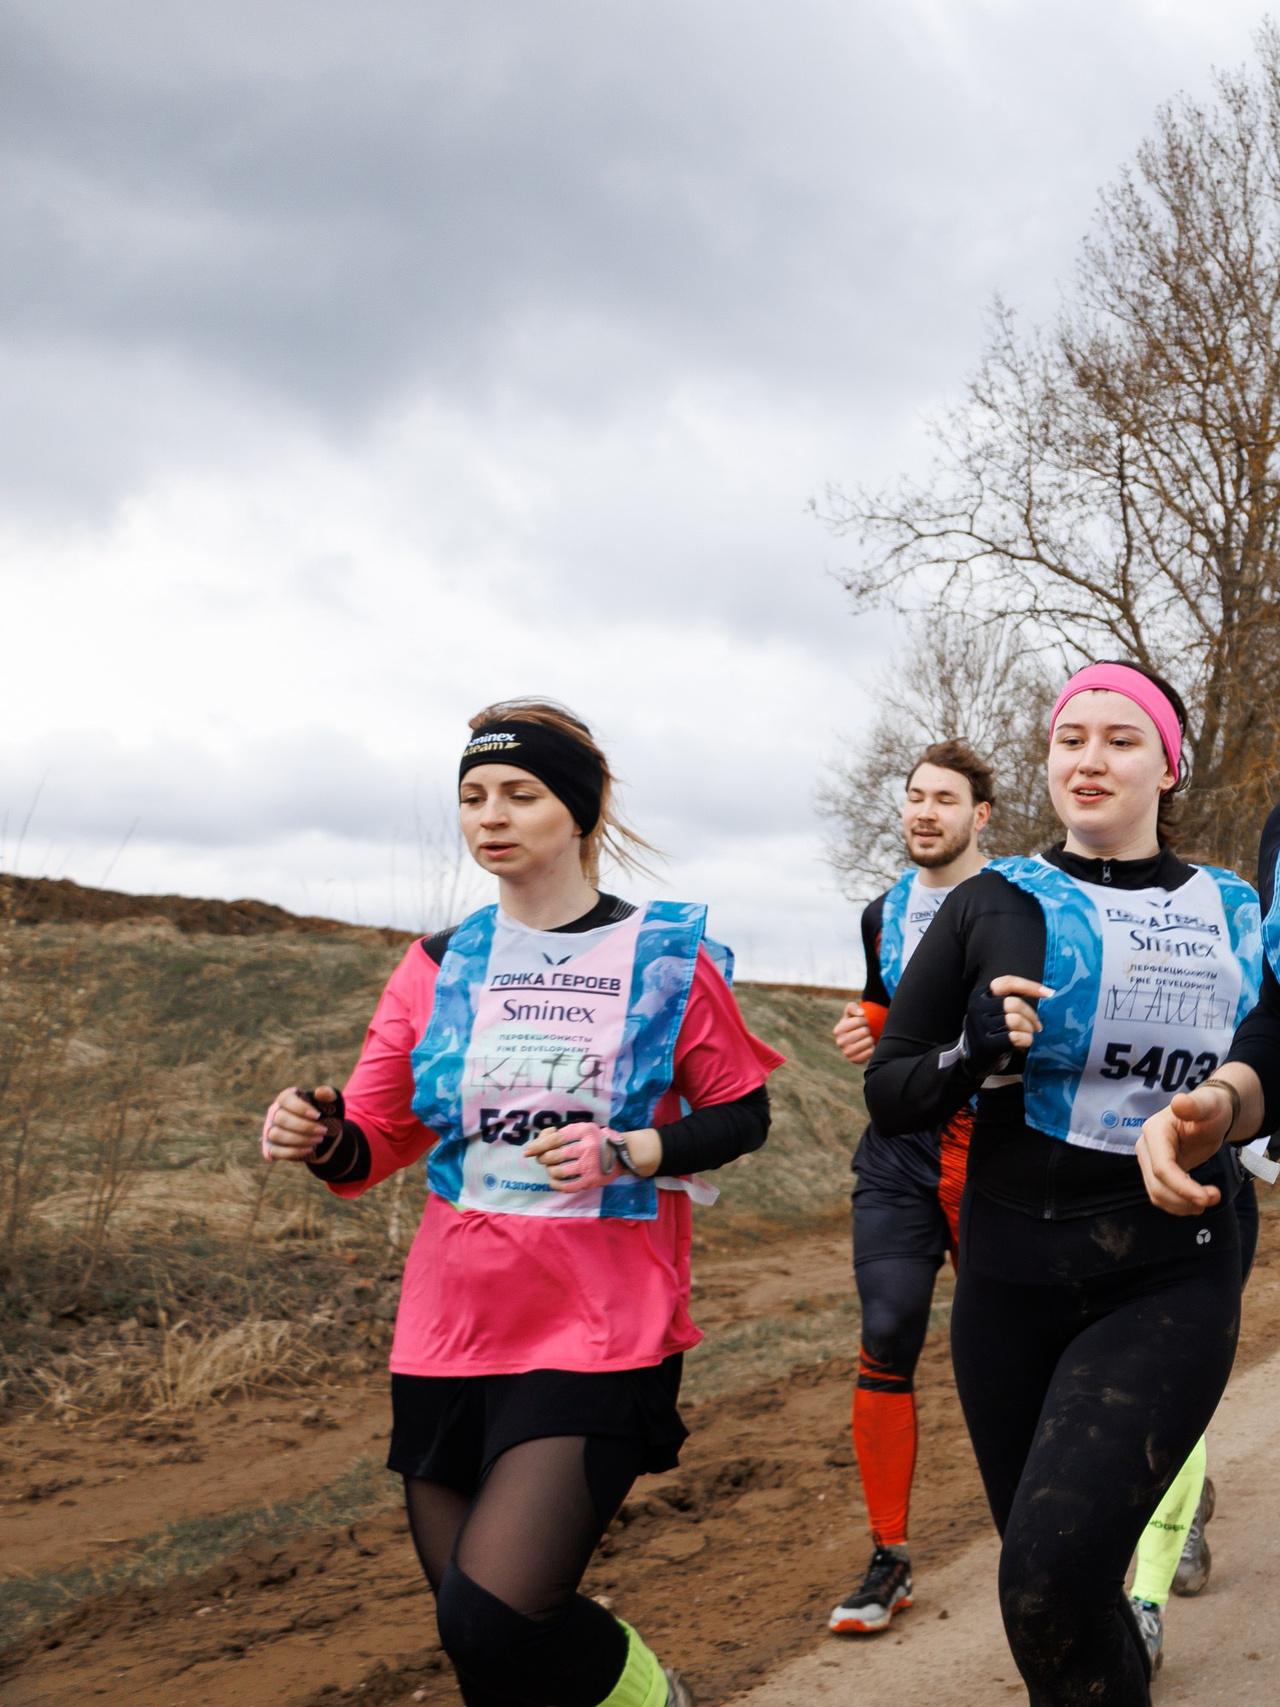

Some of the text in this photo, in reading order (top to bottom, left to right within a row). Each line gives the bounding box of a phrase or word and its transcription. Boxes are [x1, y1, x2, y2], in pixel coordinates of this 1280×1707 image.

[491, 972, 622, 991] ГОНКА ГЕРОЕВ
[502, 998, 596, 1024] Sminex
[499, 1034, 593, 1043] ПЕРФЕКЦИОНИСТЫ
[496, 1045, 590, 1054] FINE DEVELOPMENT
[1100, 1042, 1219, 1093] 5403
